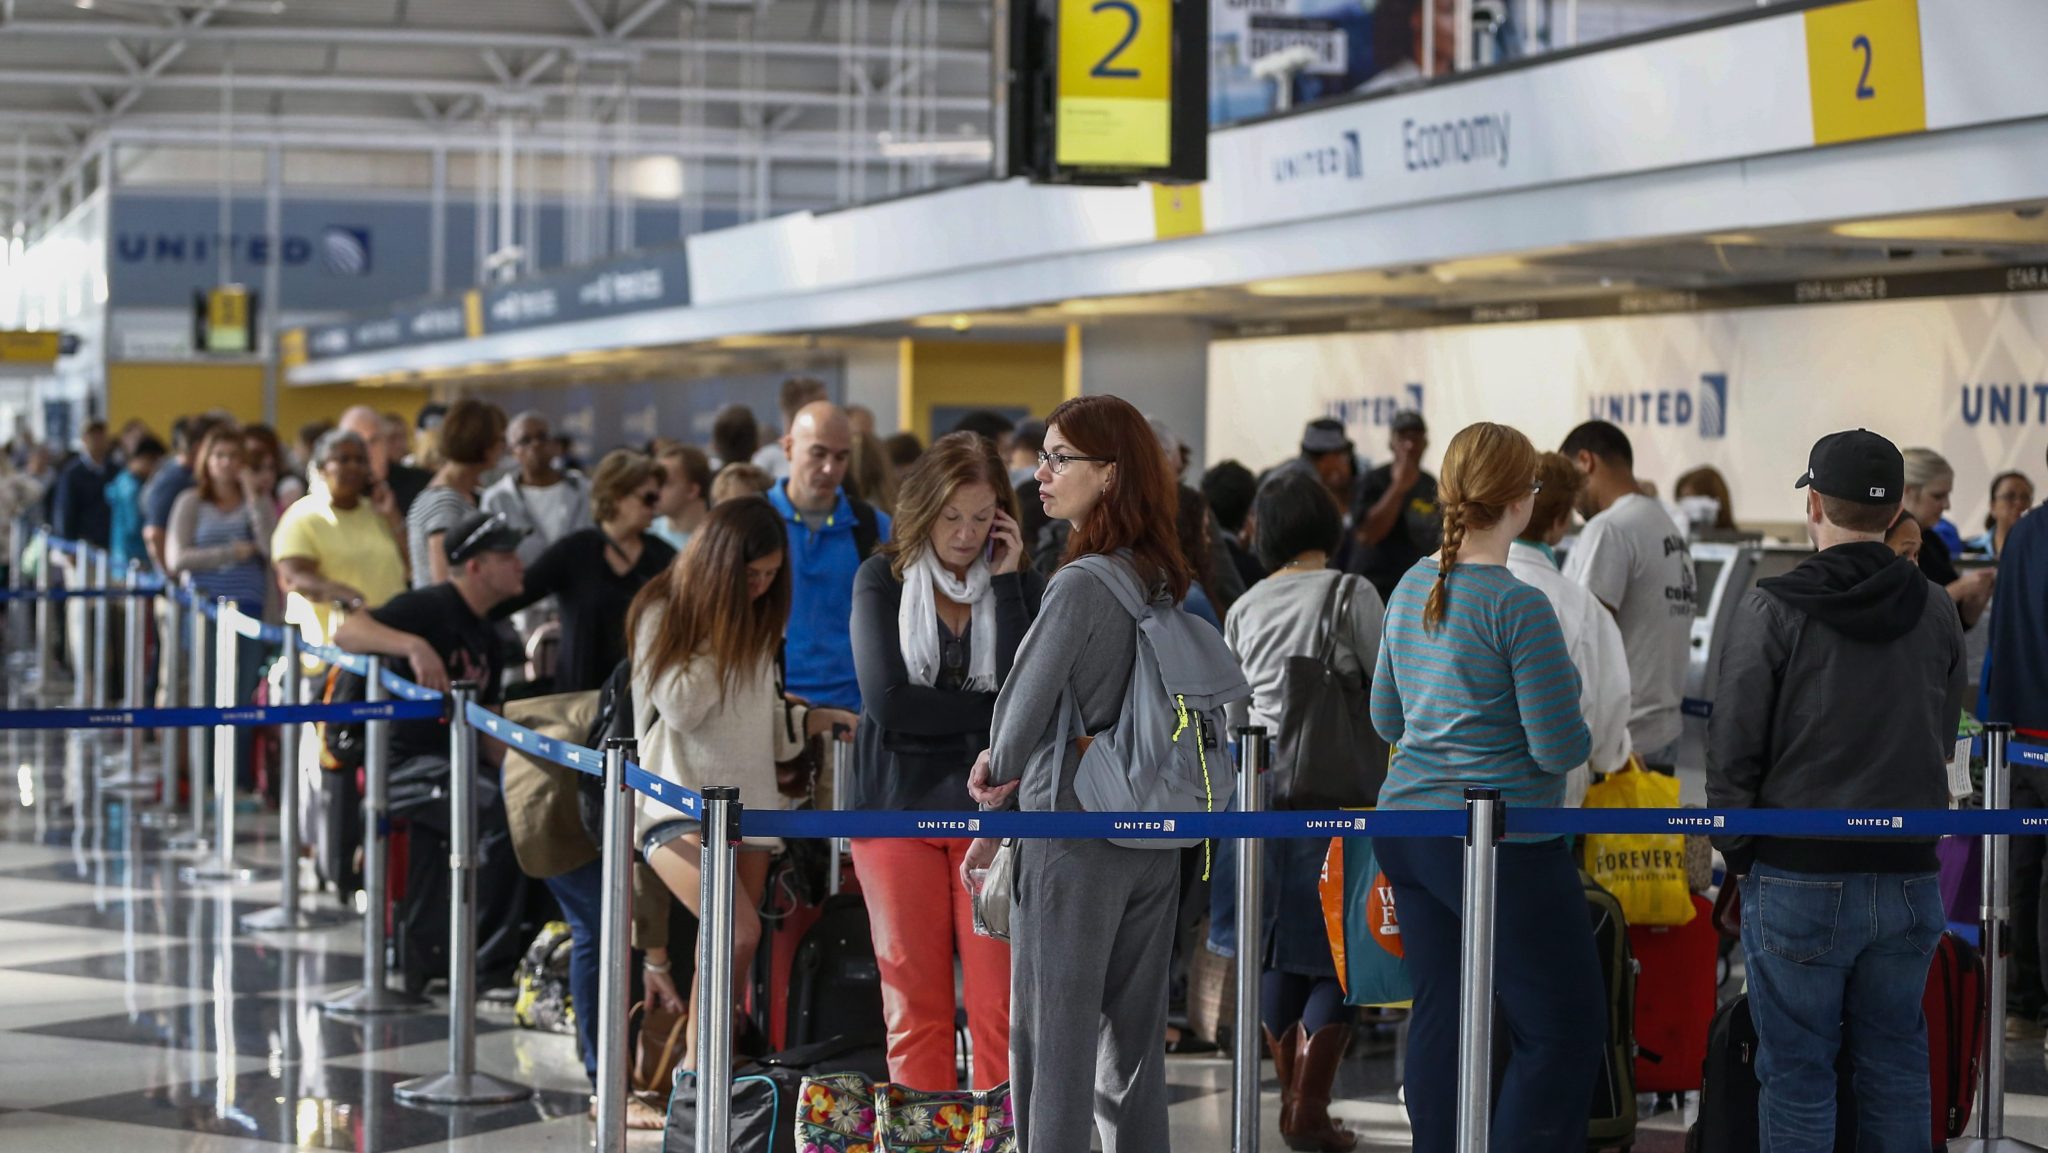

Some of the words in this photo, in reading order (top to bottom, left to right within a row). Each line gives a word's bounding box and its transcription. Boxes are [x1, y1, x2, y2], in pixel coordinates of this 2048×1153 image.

[1089, 0, 1141, 78] 2
[1852, 34, 1875, 100] 2
[1403, 111, 1511, 172] Economy
[1588, 390, 1692, 425] UNITED
[2023, 751, 2044, 761] UNITED
[917, 821, 966, 829] UNITED
[1114, 822, 1161, 830] UNITED
[1306, 820, 1352, 828] UNITED
[1667, 817, 1711, 826] UNITED
[1847, 818, 1890, 826] UNITED
[1597, 849, 1673, 874] FOREVER
